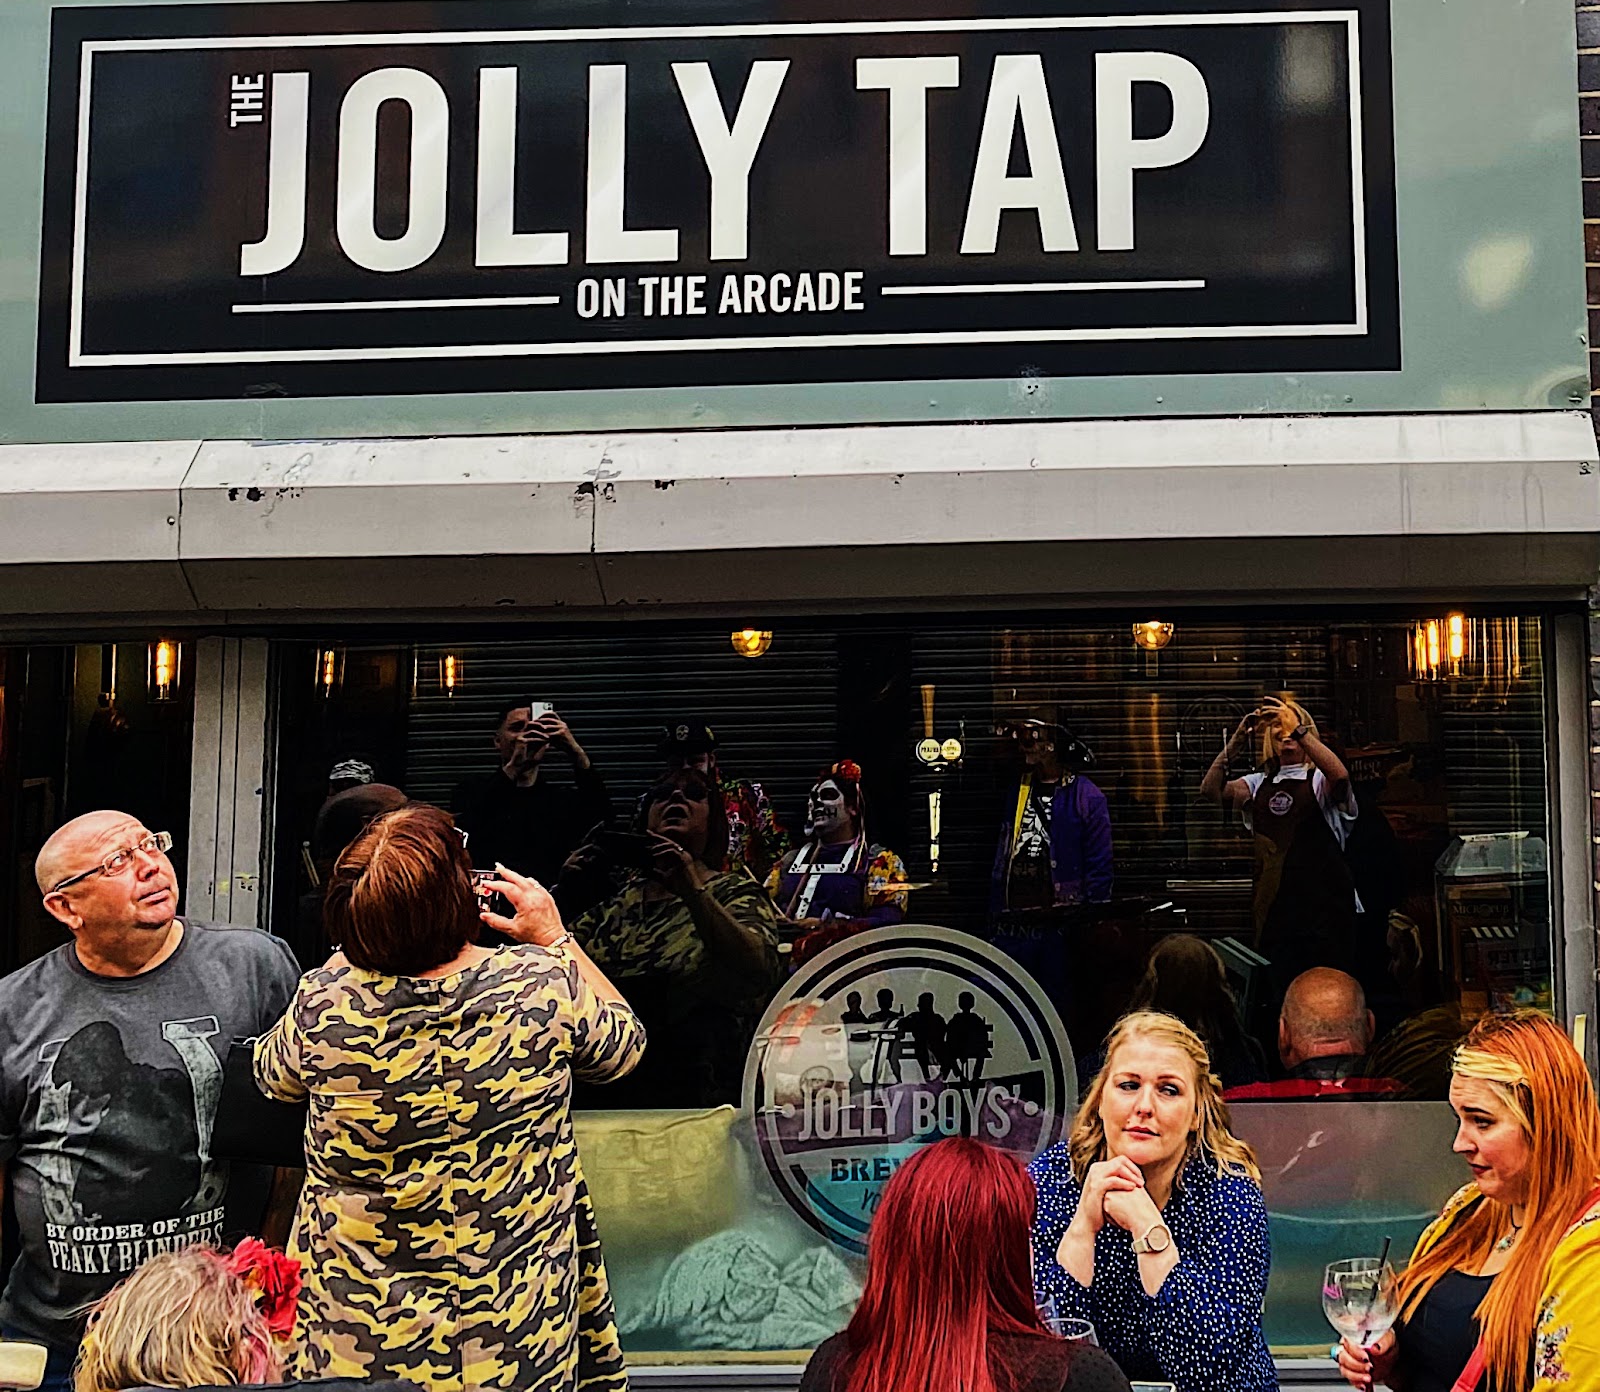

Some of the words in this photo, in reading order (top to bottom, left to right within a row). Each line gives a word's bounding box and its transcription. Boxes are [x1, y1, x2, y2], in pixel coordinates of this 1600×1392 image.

[230, 74, 264, 128] THE
[240, 59, 791, 276] JOLLY
[856, 51, 1210, 256] TAP
[577, 277, 626, 318] ON
[638, 275, 707, 316] THE
[718, 271, 864, 315] ARCADE
[798, 1086, 903, 1143] JOLLY
[912, 1083, 1022, 1139] BOYS'
[46, 1222, 67, 1240] BY
[72, 1223, 147, 1242] ORDER
[152, 1218, 181, 1236] OF
[185, 1206, 225, 1229] THE
[47, 1238, 112, 1274] PEAKY
